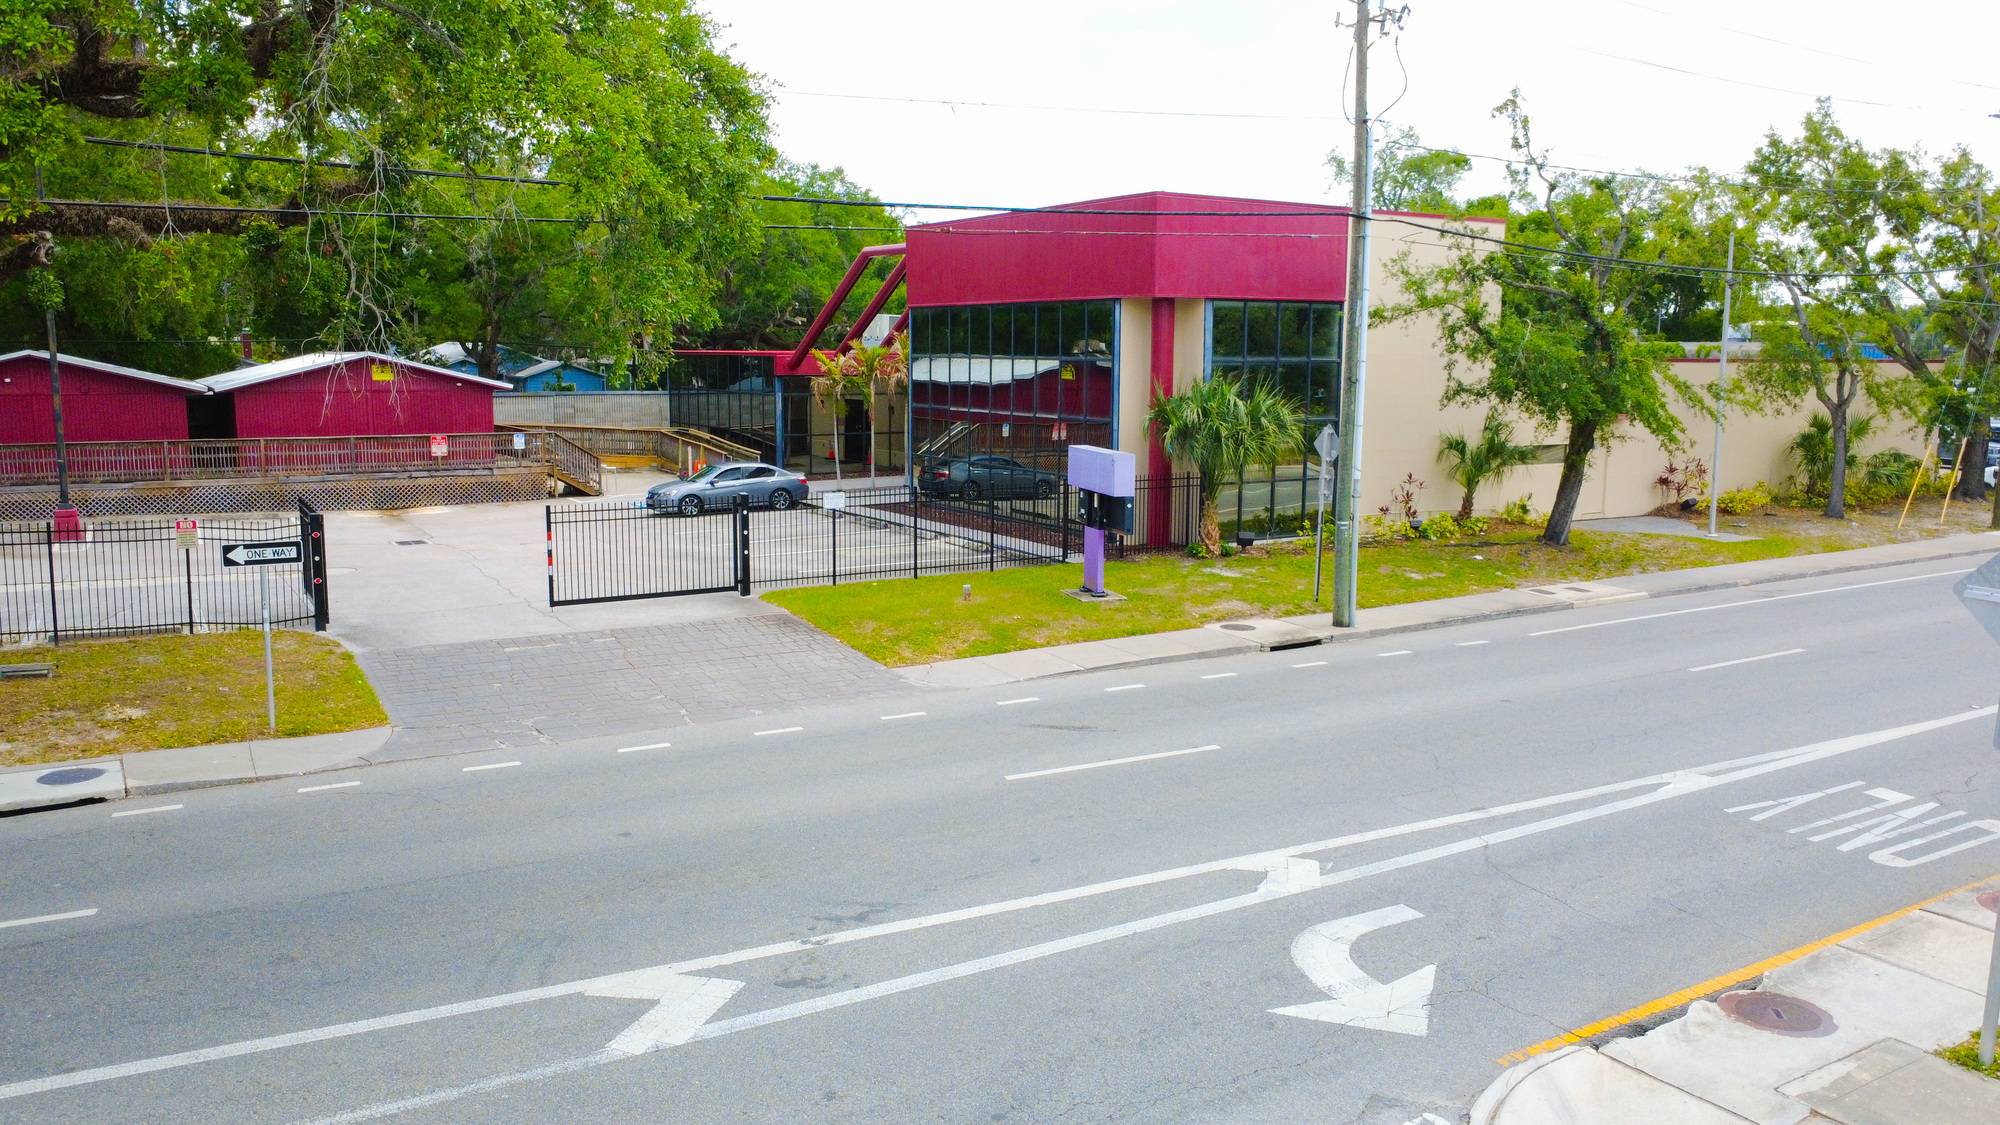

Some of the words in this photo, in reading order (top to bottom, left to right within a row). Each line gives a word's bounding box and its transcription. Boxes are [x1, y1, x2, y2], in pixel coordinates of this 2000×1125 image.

[179, 521, 193, 529] NO
[246, 550, 268, 559] ONE
[271, 548, 293, 558] WAY
[1723, 780, 2000, 868] ONLY
